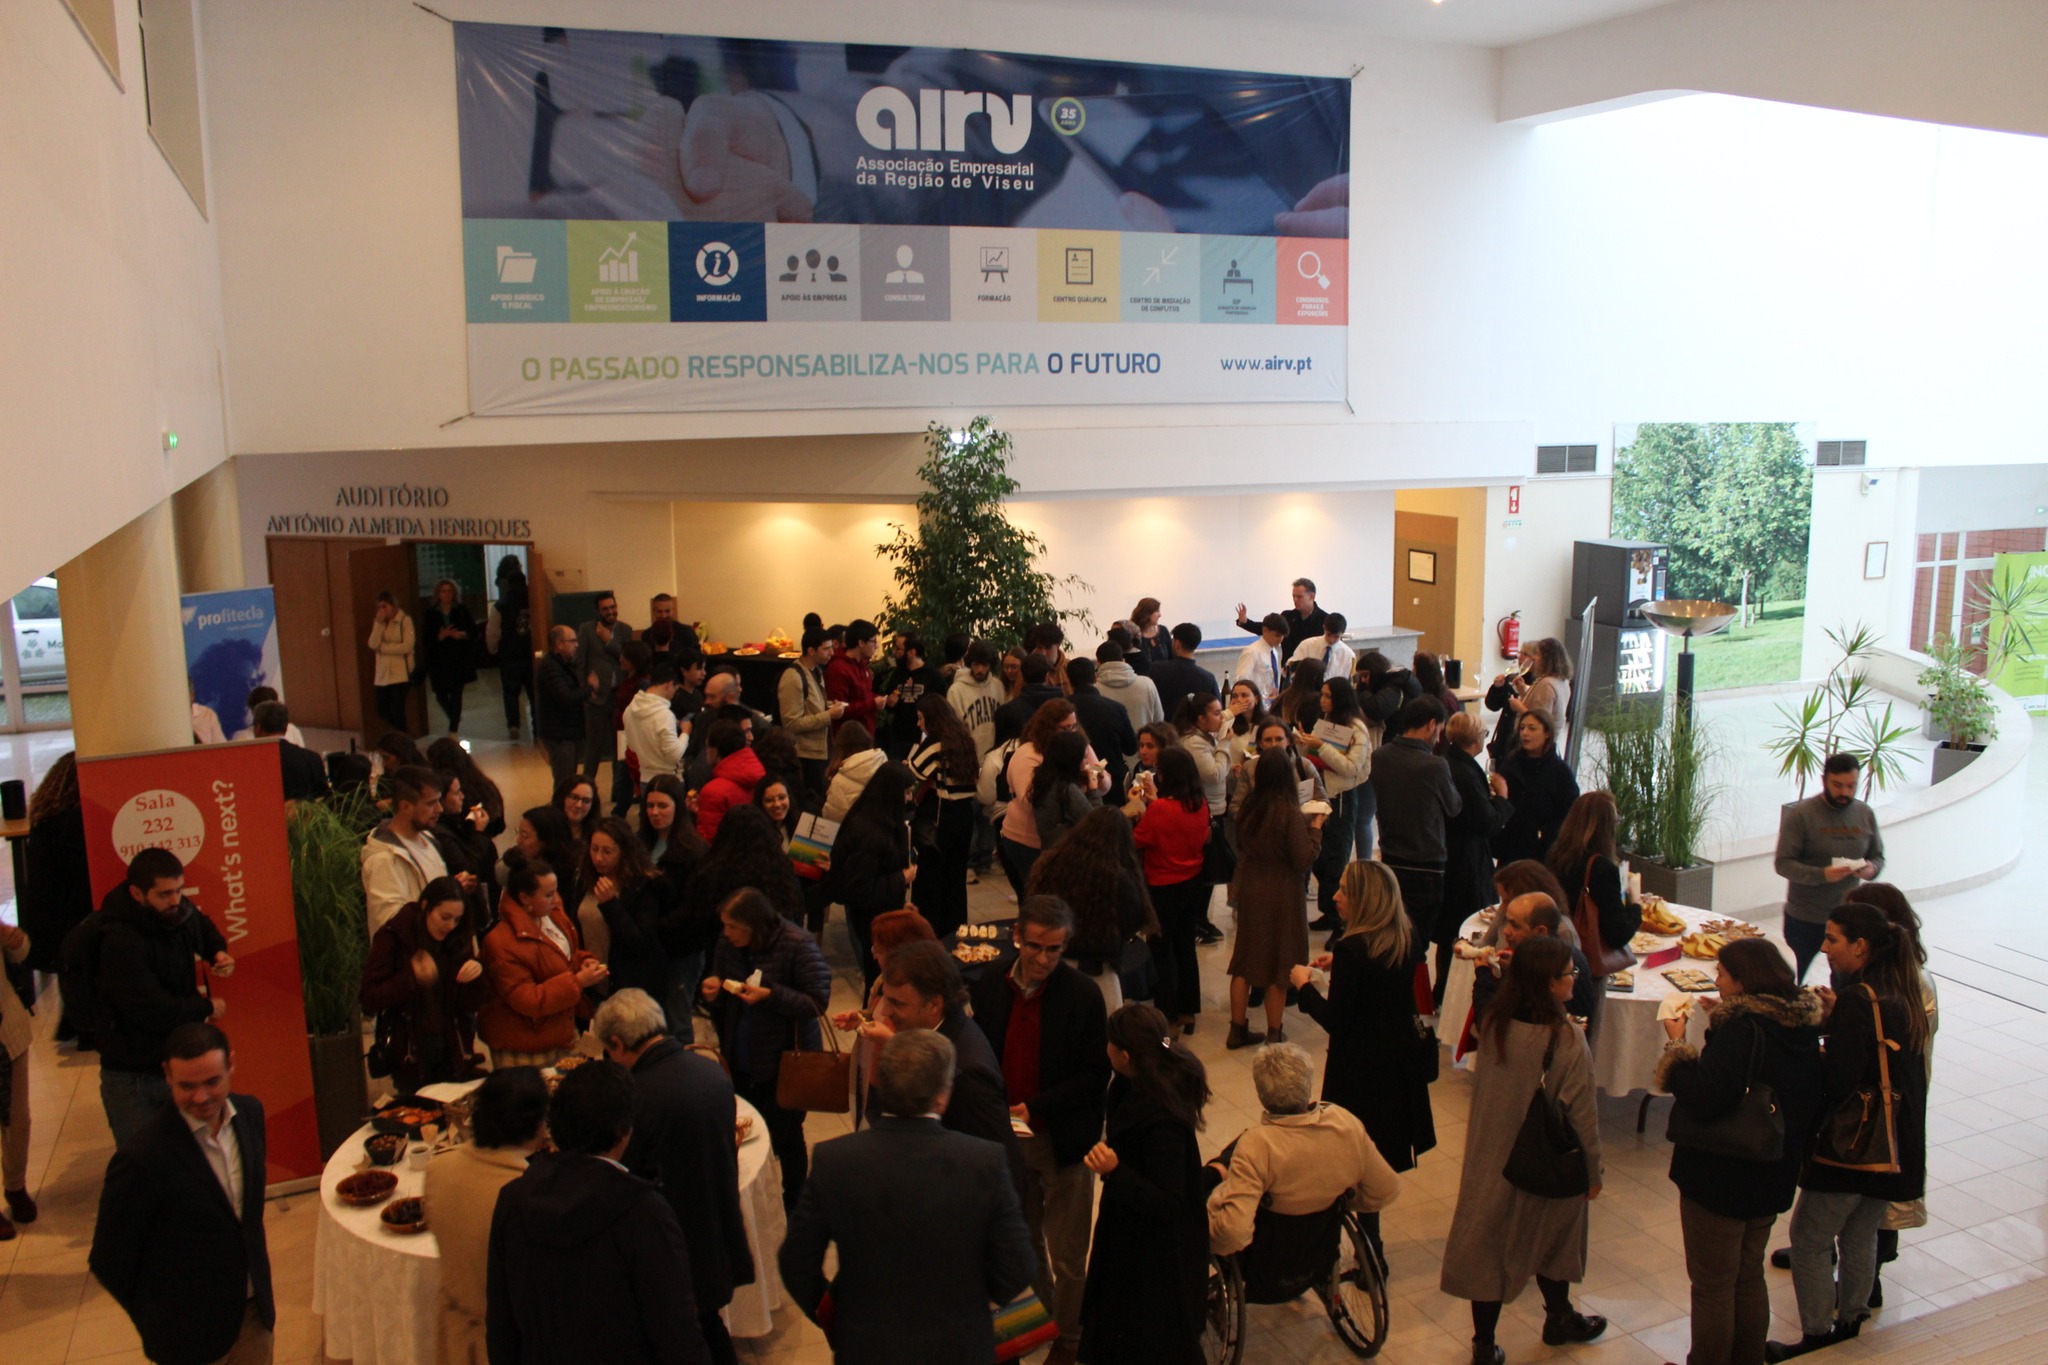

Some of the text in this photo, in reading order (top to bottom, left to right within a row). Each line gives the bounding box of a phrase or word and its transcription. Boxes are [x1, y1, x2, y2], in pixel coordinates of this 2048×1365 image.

[1060, 107, 1077, 120] 35
[856, 156, 1034, 177] Associação Empresarial
[856, 171, 1035, 191] da Região de Viseu
[696, 293, 741, 304] INFORMAÇÃO
[781, 294, 801, 302] APOIO
[813, 294, 847, 302] EMPRESAS
[977, 294, 1011, 303] FORMAÇÃO
[1053, 295, 1107, 303] CENTRO QUALIFICA
[1161, 296, 1191, 306] MEDIAÇÃO
[1141, 305, 1180, 313] DE CONFLITOS
[521, 352, 1161, 382] O PASSADO RESPONSABILIZA-NOS PARA O FUTURO
[1220, 356, 1313, 375] www.airv.pt
[335, 483, 449, 508] AUDITÓRIO
[267, 513, 531, 538] ANTÓNIO ALMEIDA HENRIQUES
[135, 793, 176, 813] Sala
[142, 816, 175, 836] 232
[120, 843, 144, 858] 910
[177, 835, 202, 849] 313
[212, 779, 248, 943] What's next?
